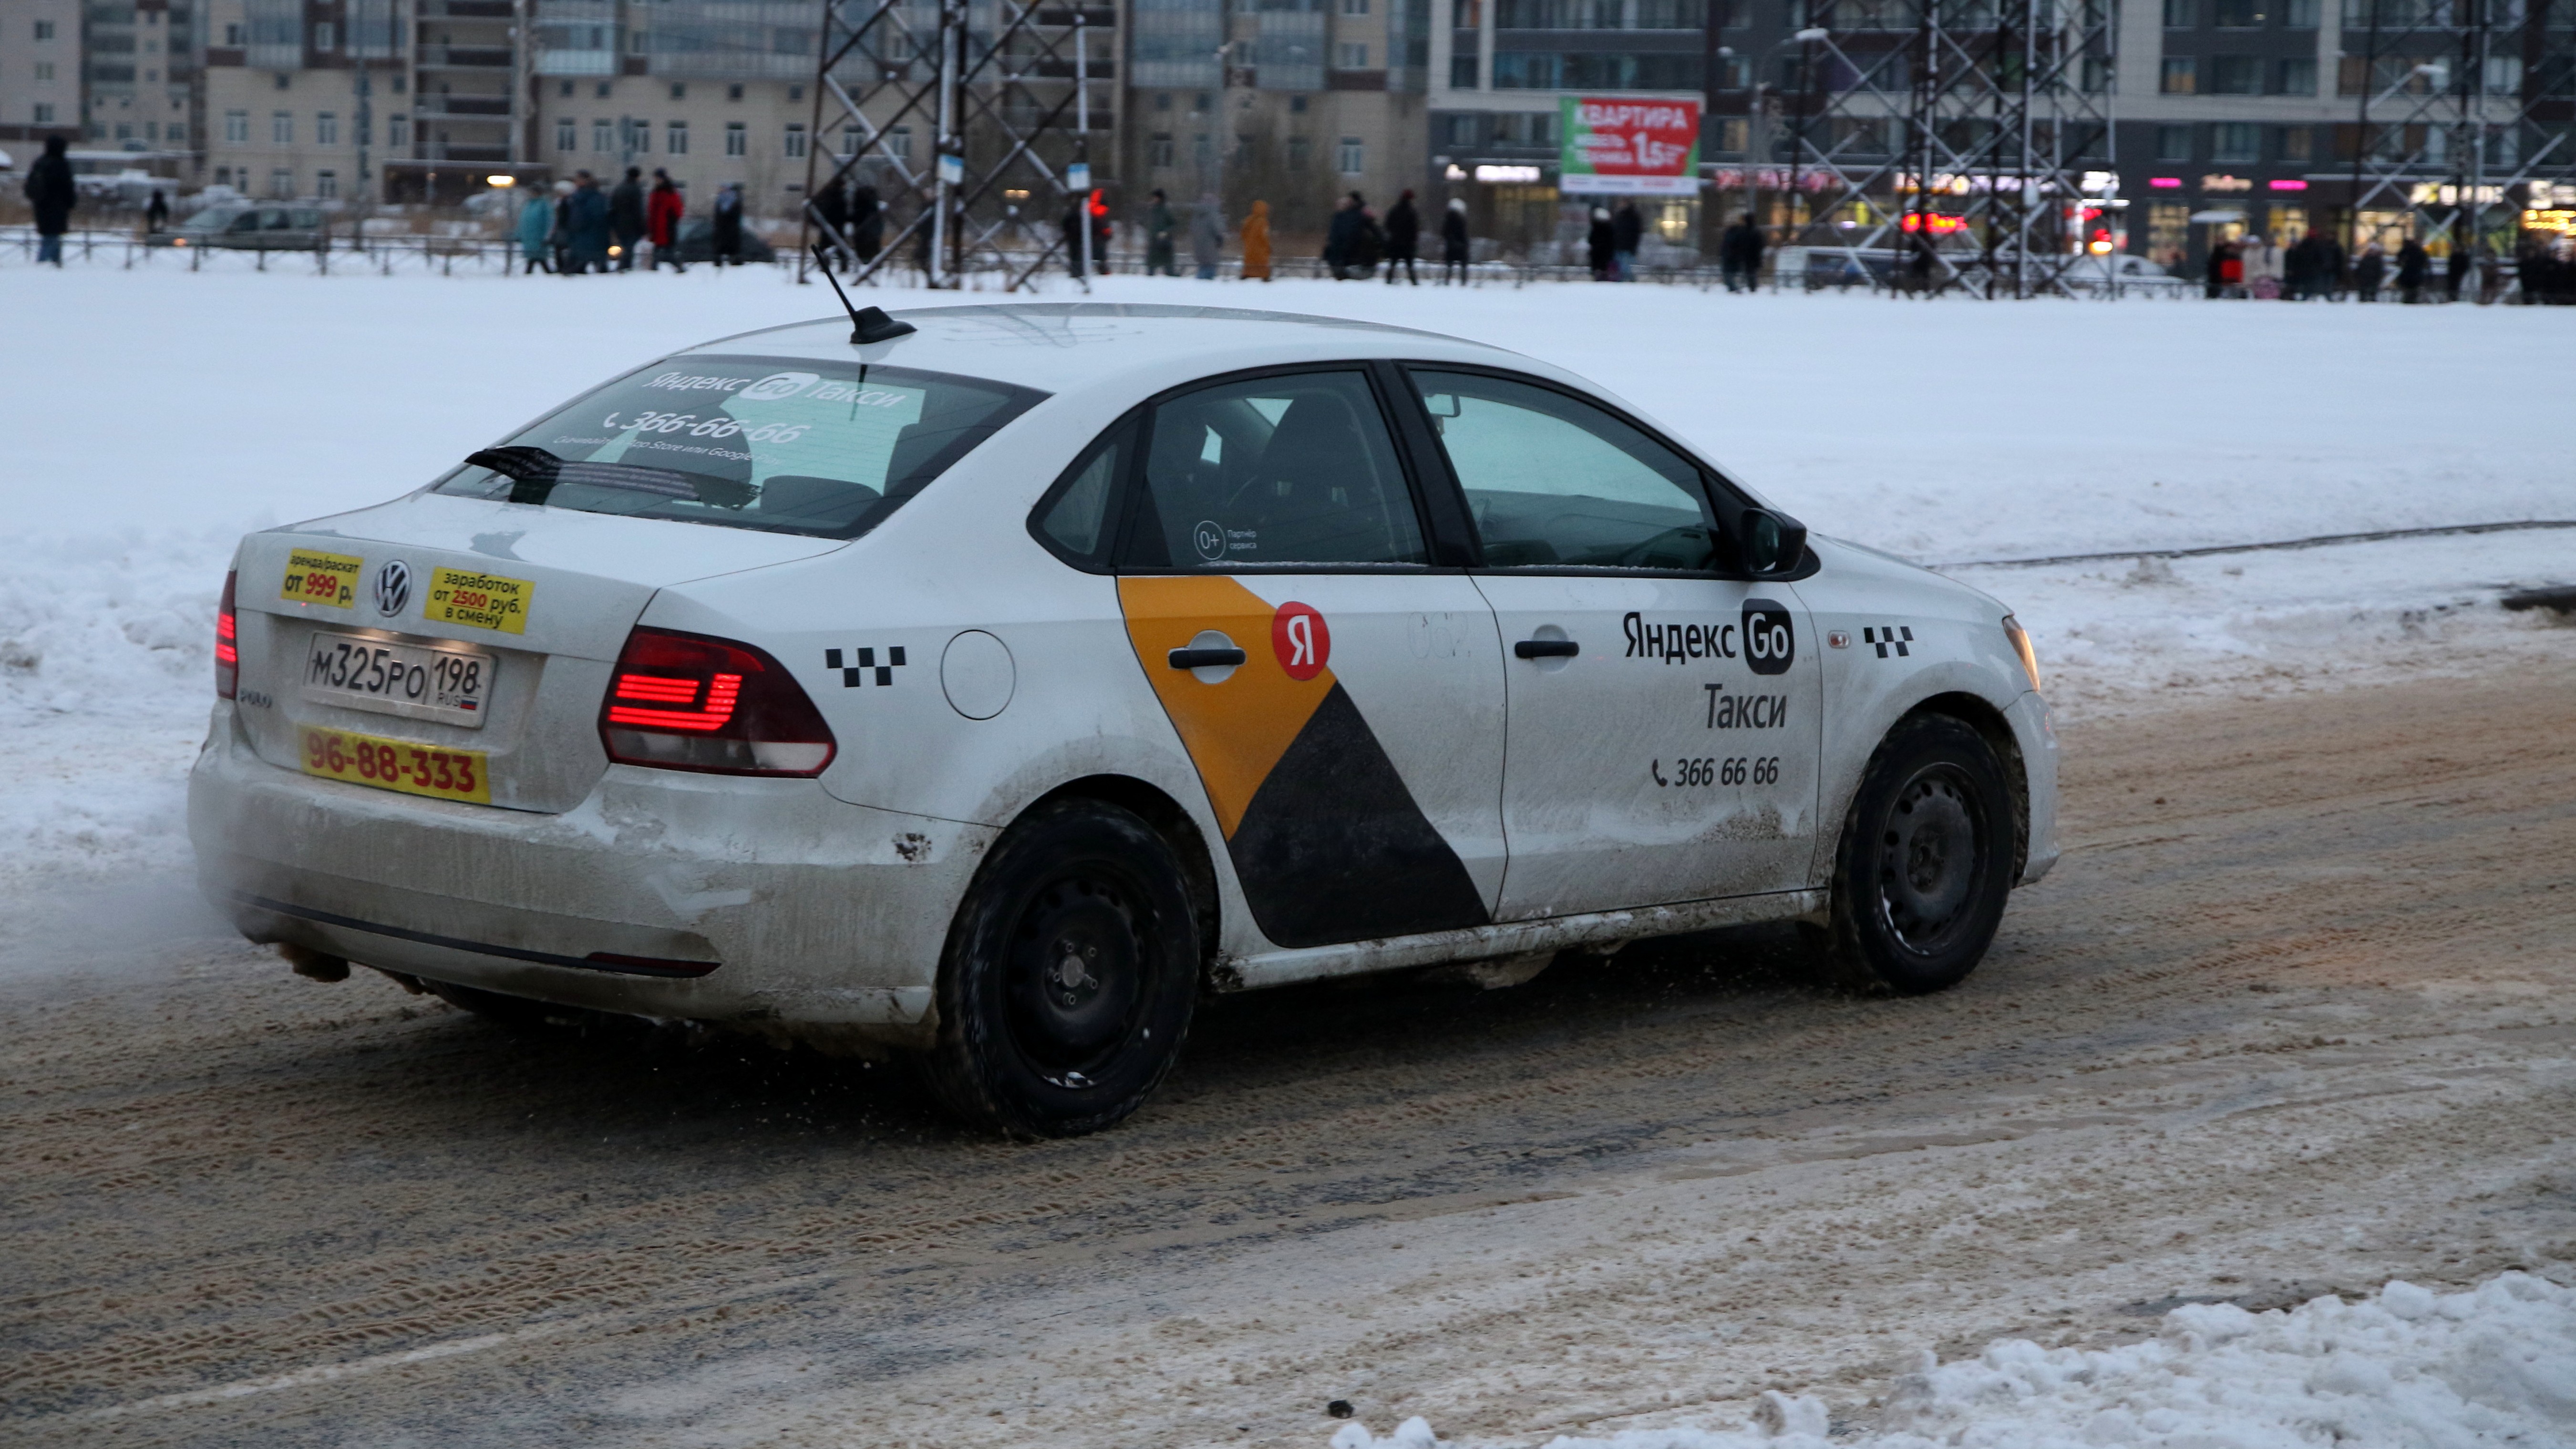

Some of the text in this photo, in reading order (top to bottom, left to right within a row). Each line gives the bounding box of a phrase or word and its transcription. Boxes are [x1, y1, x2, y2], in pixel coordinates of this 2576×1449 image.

[1574, 104, 1688, 129] КВАРТИРА
[641, 371, 907, 407] Яндекс Go Такси
[620, 411, 812, 444] 366-66-66
[649, 441, 683, 451] Store
[708, 447, 754, 460] Google
[1200, 530, 1219, 549] 0+
[305, 573, 337, 597] 999
[338, 586, 352, 604] р.
[444, 573, 521, 595] заработок
[433, 590, 521, 614] от 2500 руб.
[445, 607, 504, 629] в смену
[1288, 615, 1314, 666] Я
[1623, 608, 1791, 665] Яндекс Go
[434, 656, 479, 693] 198
[436, 692, 461, 707] RUS
[1705, 683, 1787, 728] Такси
[308, 731, 474, 792] 96-88-333
[1675, 756, 1780, 787] 366 66 66
